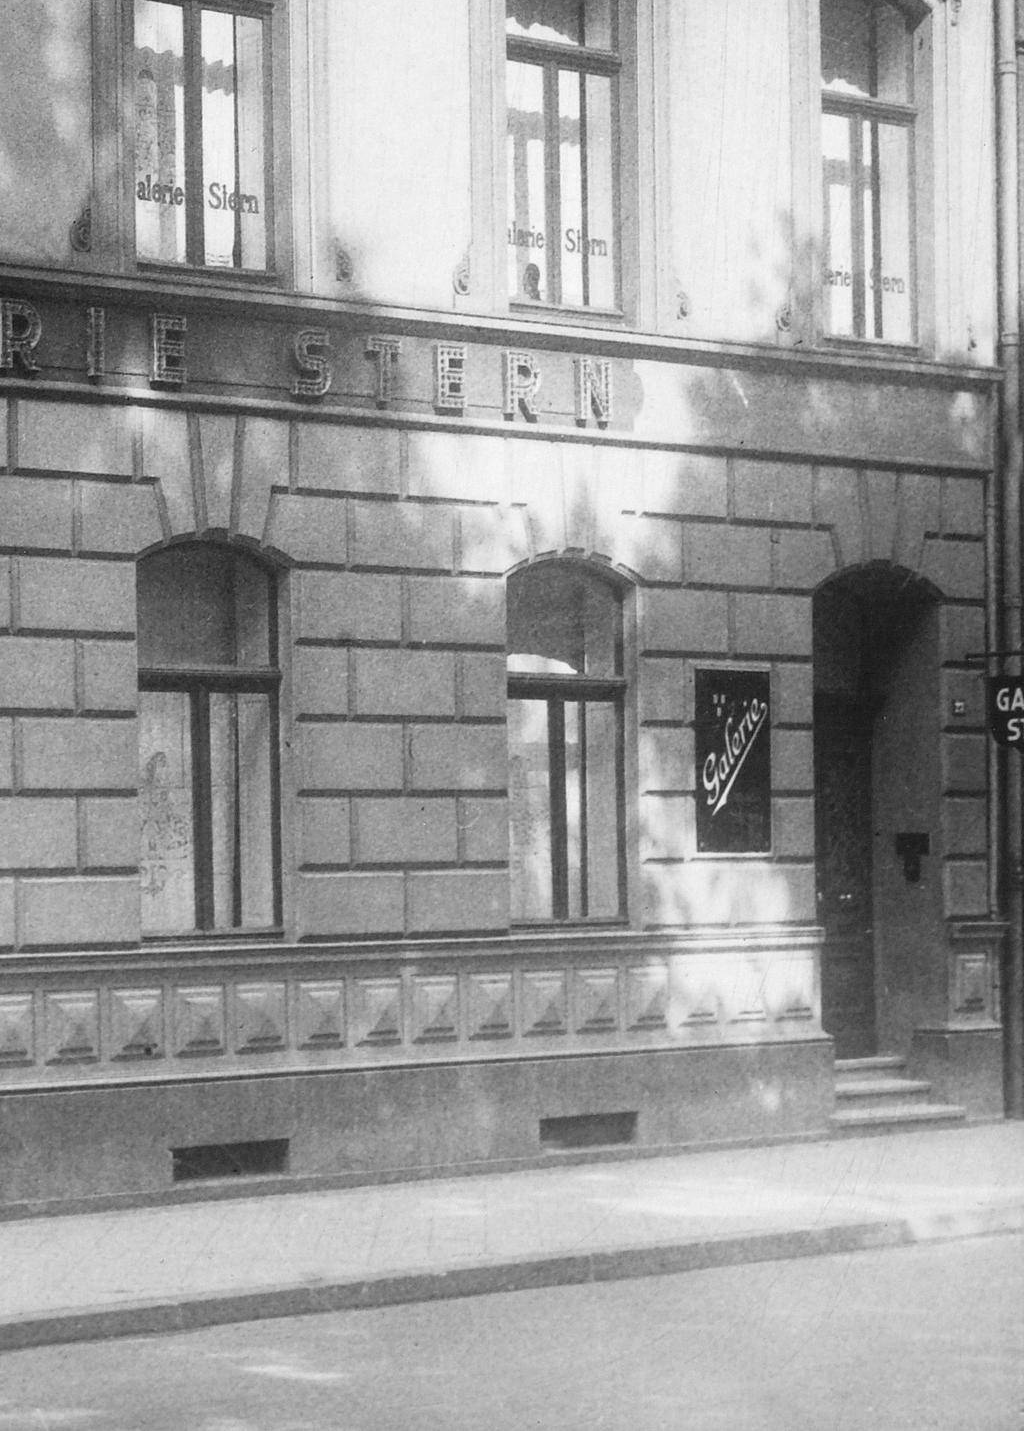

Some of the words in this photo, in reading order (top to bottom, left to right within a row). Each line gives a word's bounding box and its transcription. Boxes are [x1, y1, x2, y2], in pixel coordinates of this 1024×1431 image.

[136, 174, 184, 206] alerie
[565, 228, 608, 256] Strn
[290, 327, 613, 427] STERN
[703, 697, 764, 808] Galerie
